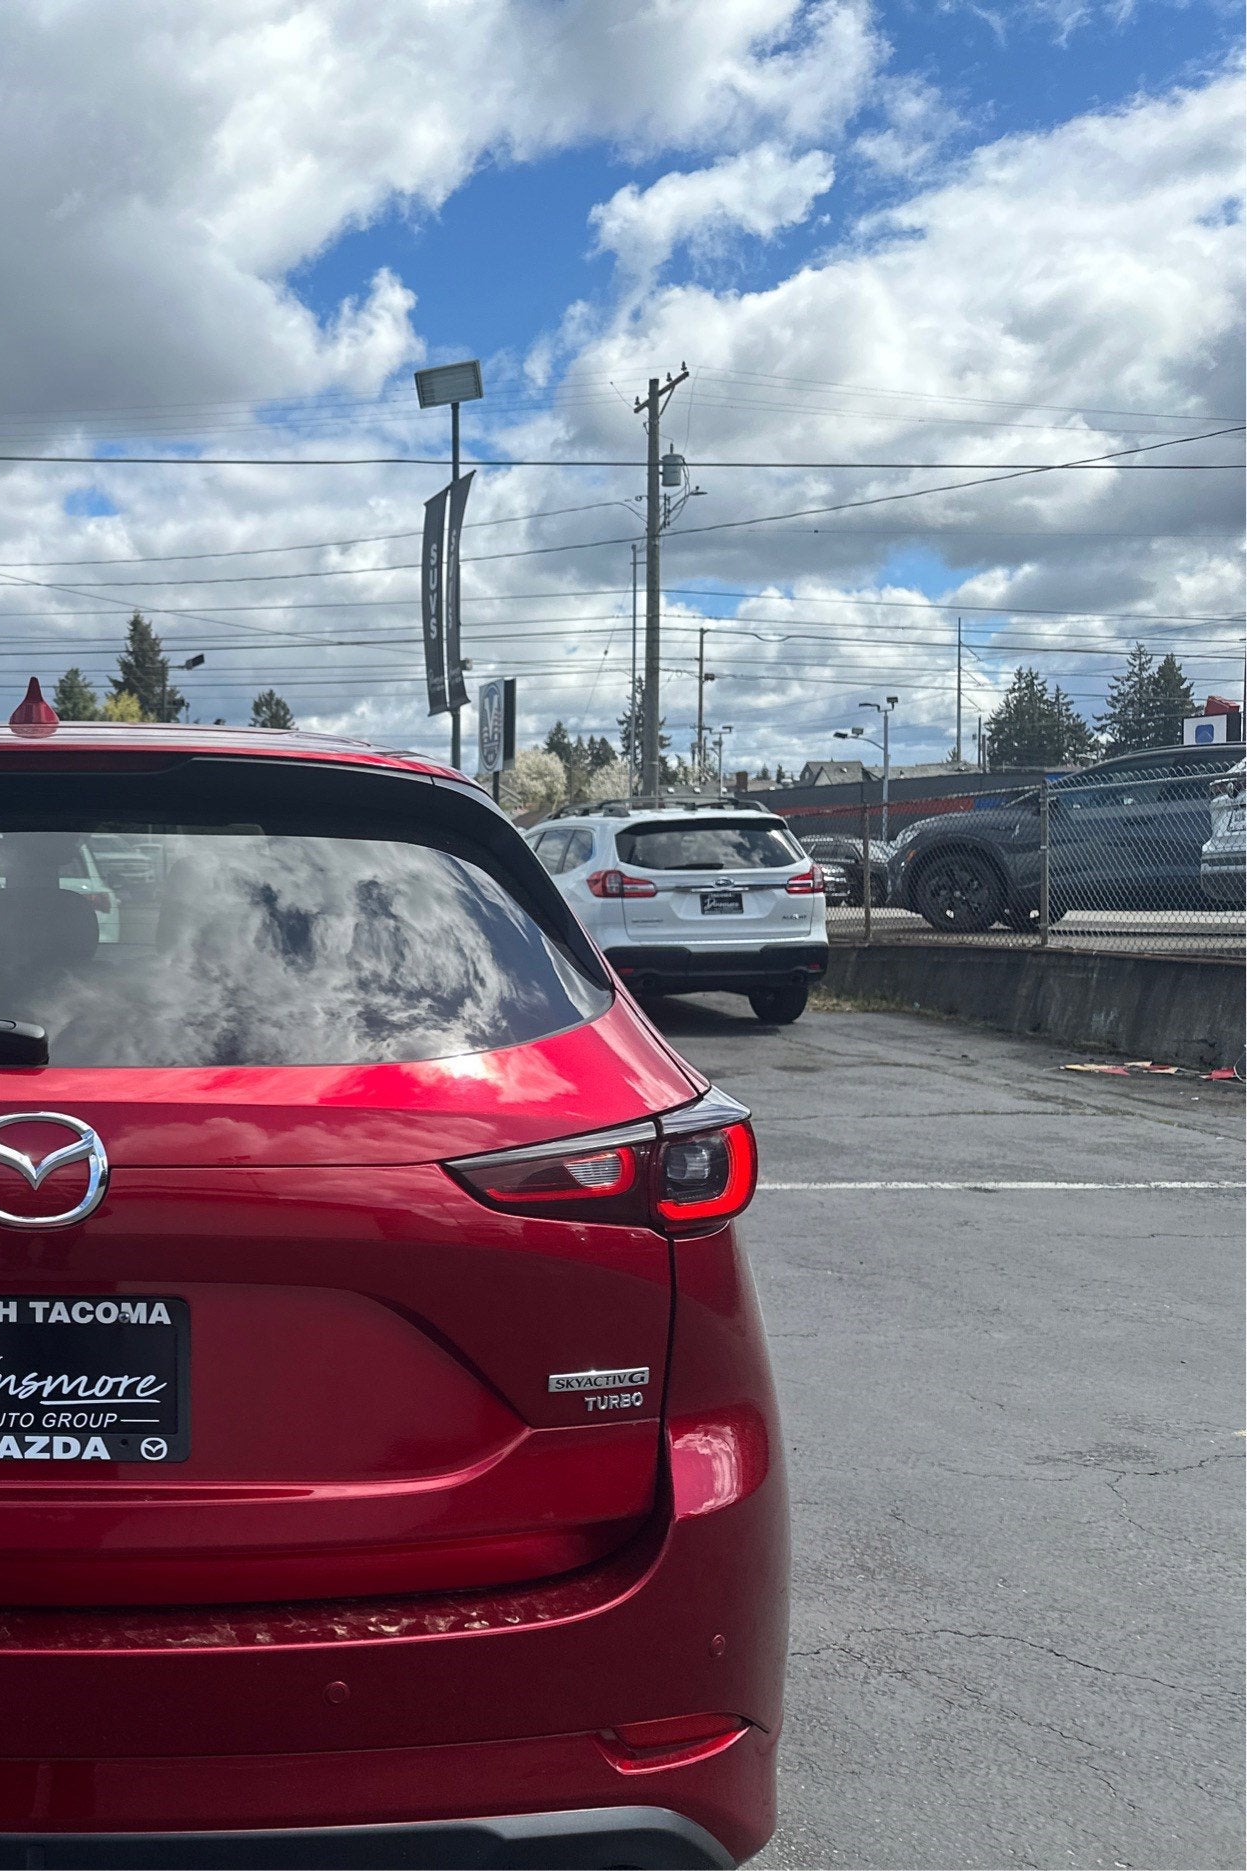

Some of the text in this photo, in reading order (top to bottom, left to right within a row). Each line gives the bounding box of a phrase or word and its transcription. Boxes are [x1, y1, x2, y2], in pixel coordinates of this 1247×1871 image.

[429, 543, 438, 640] SUVS
[29, 1301, 172, 1325] TACOMA
[584, 1391, 644, 1412] TURBO
[41, 1412, 119, 1428] GROUP
